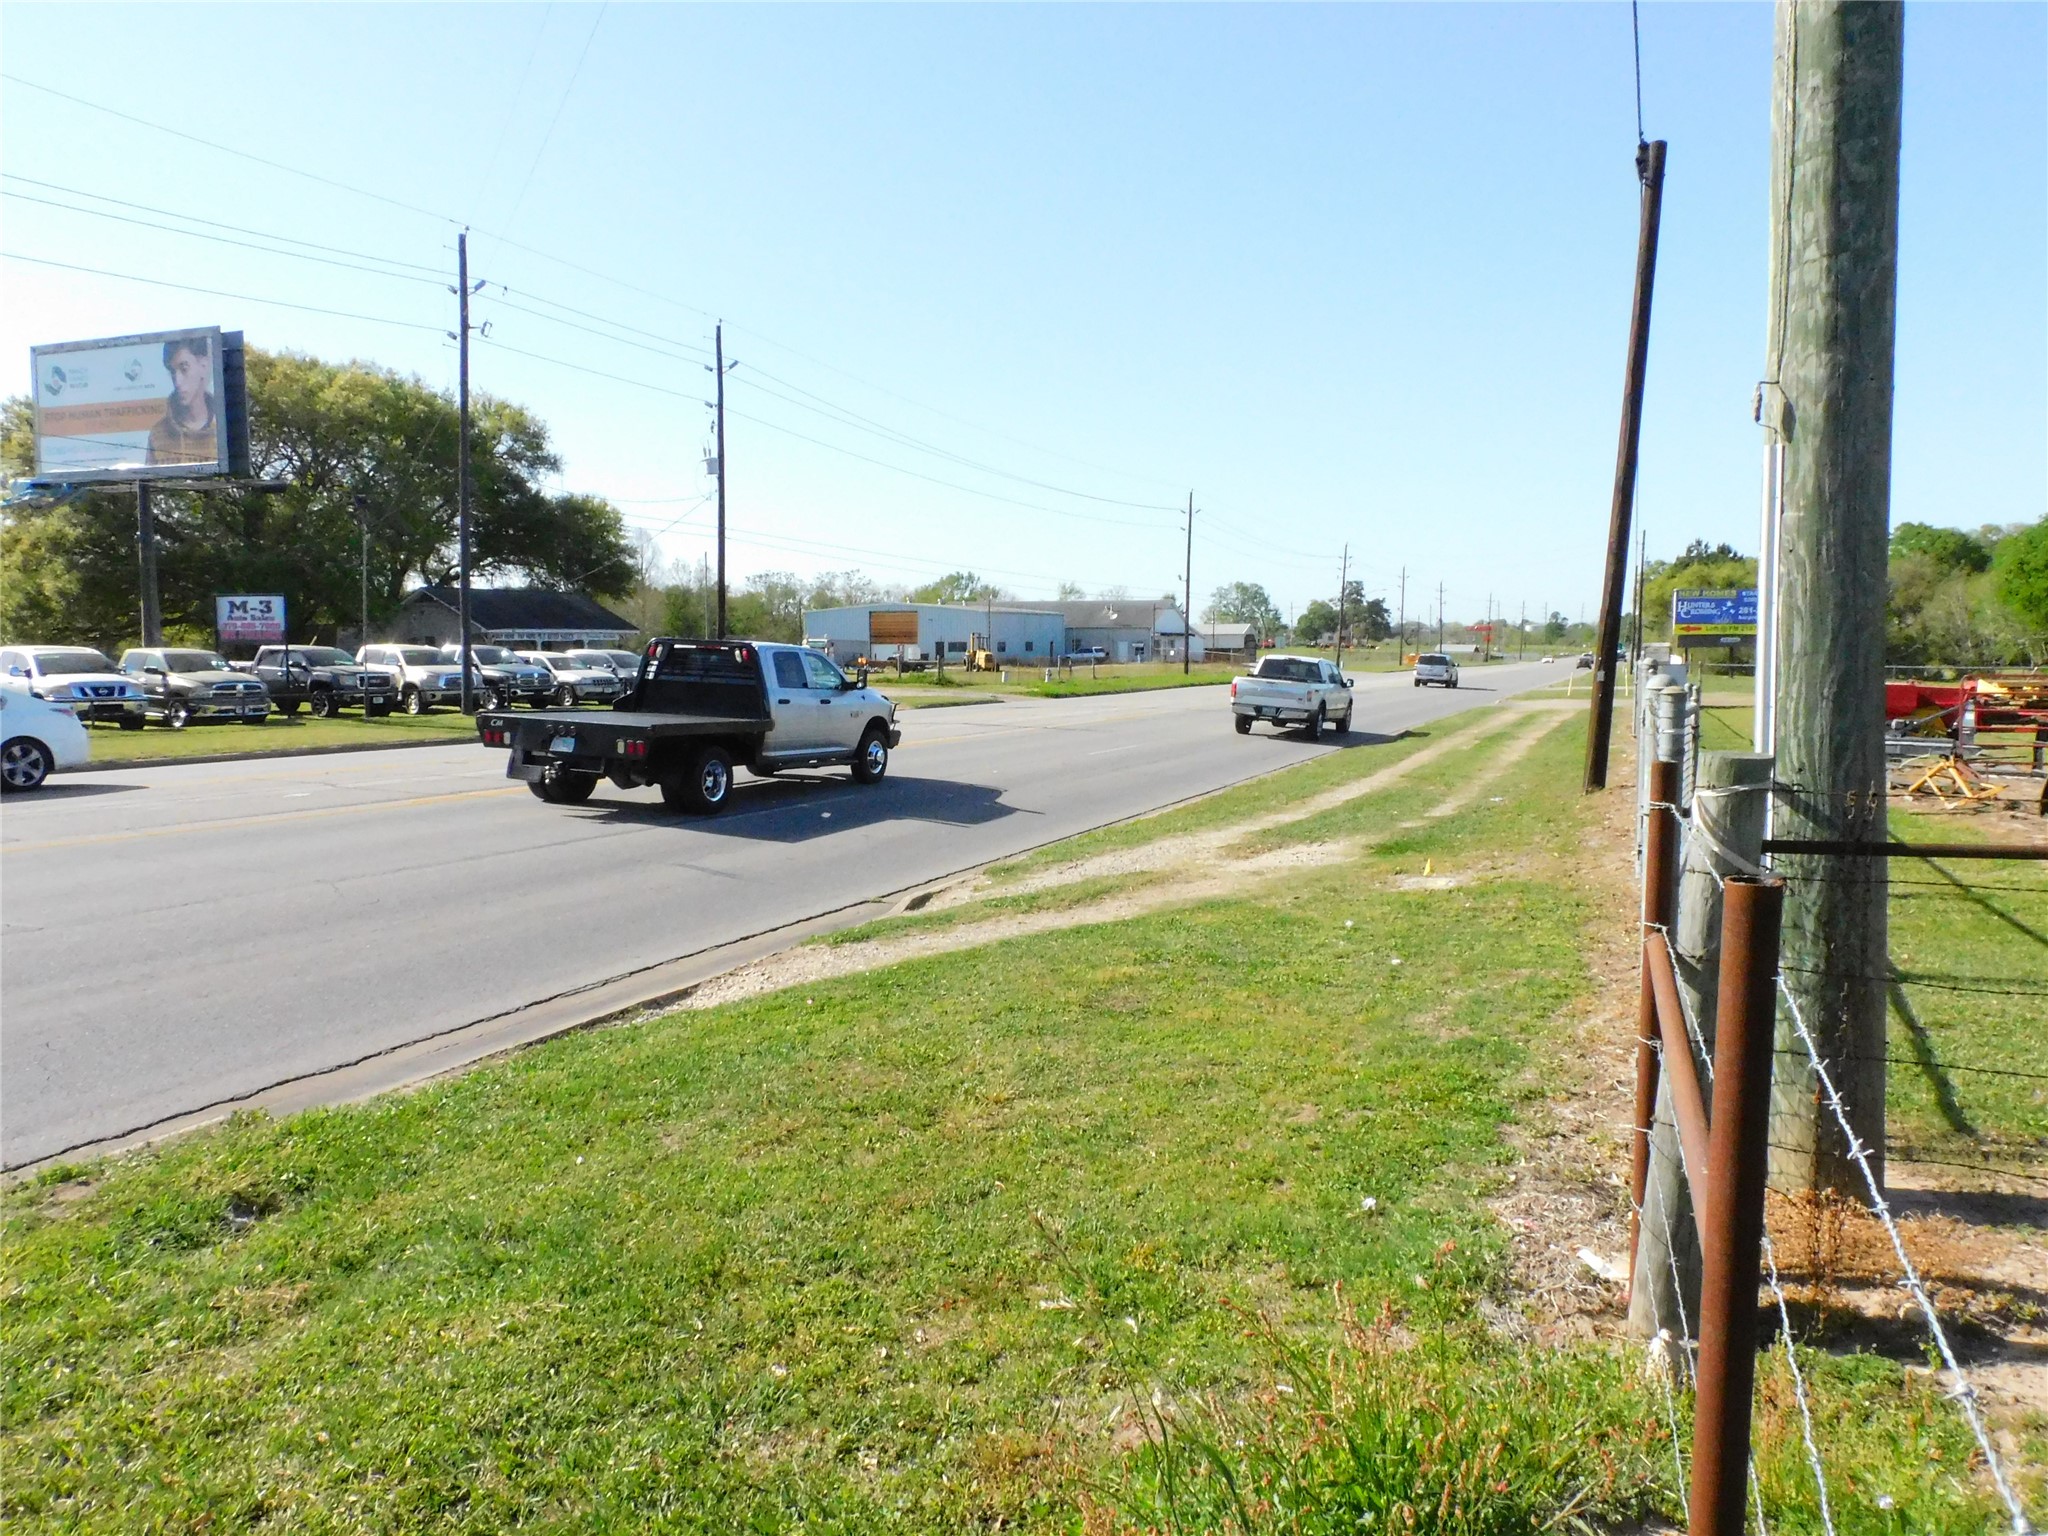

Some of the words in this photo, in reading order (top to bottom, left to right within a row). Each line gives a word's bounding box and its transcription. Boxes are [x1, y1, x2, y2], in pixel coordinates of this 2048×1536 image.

[68, 409, 101, 419] HUMAN
[104, 404, 165, 417] TRAFFICKING
[227, 600, 272, 614] M-3
[1678, 601, 1716, 612] HUNTERS
